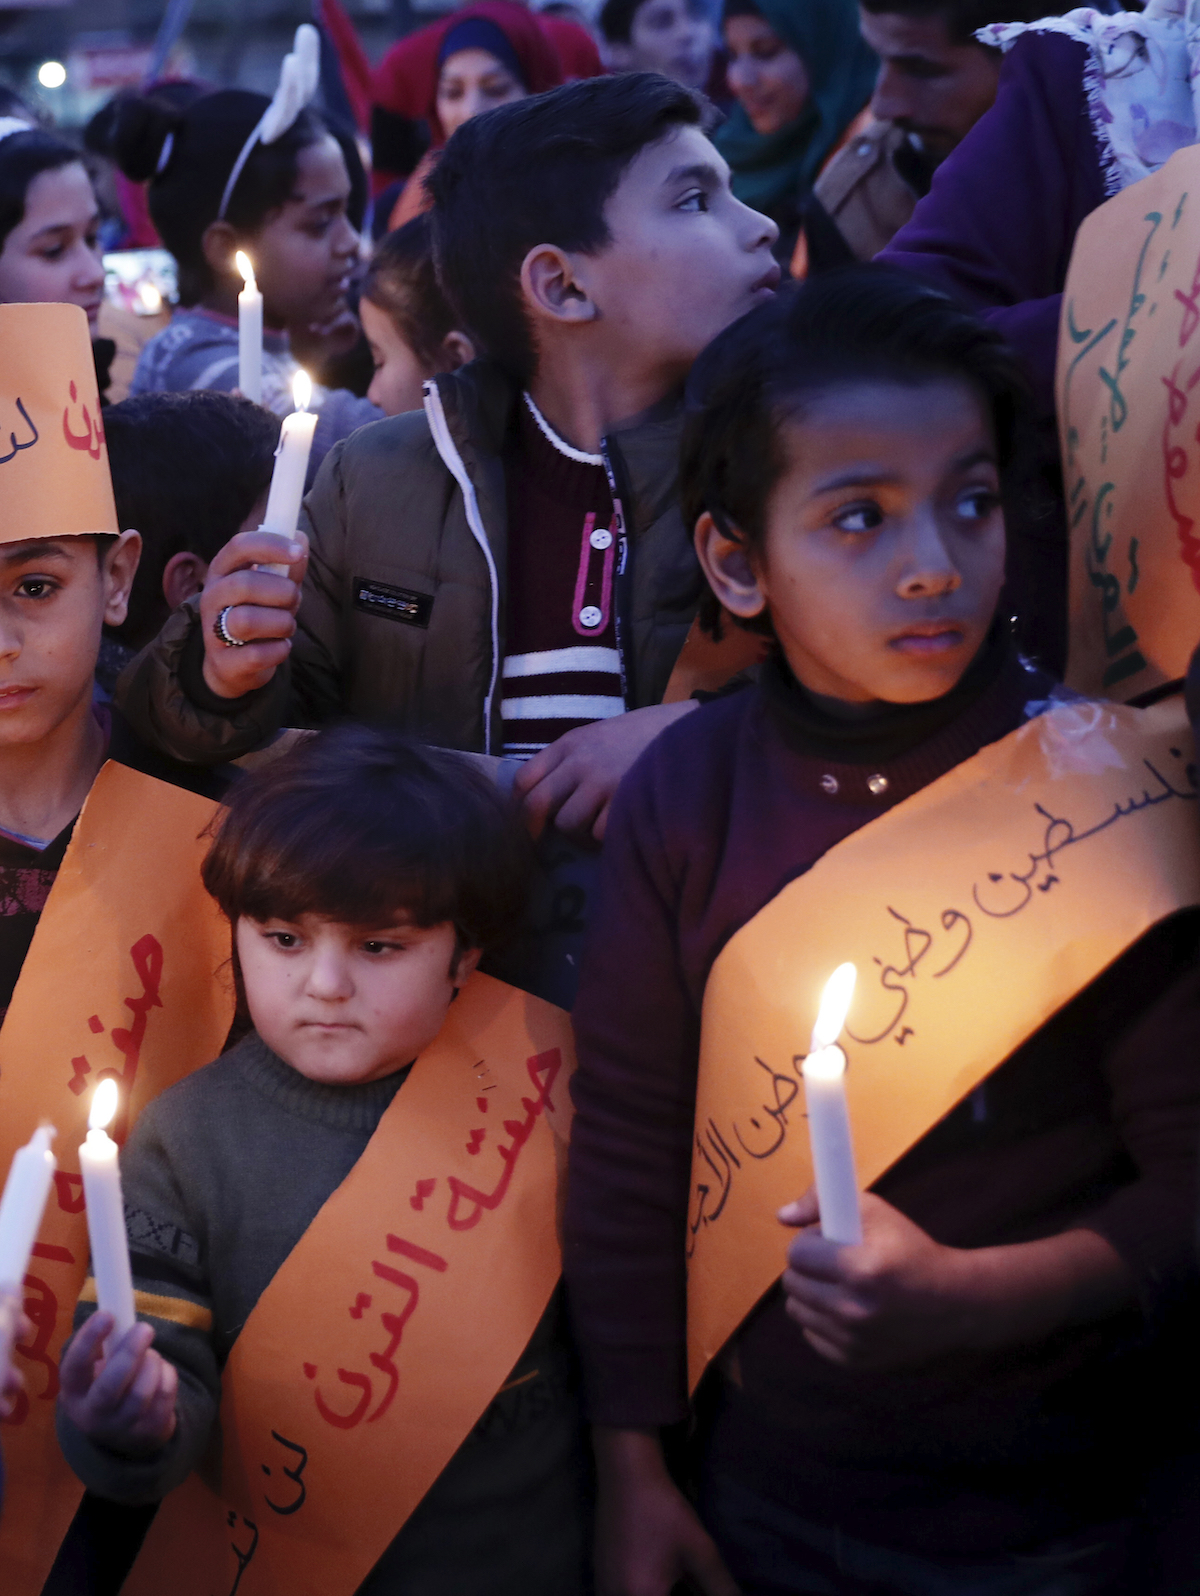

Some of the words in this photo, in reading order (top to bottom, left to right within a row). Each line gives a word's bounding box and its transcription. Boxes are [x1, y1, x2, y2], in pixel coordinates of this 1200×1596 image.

[62, 379, 106, 461] رن
[845, 905, 973, 1046] وطني
[409, 1046, 563, 1231] صفقة
[302, 1232, 449, 1430] القرن
[261, 1429, 308, 1516] لن
